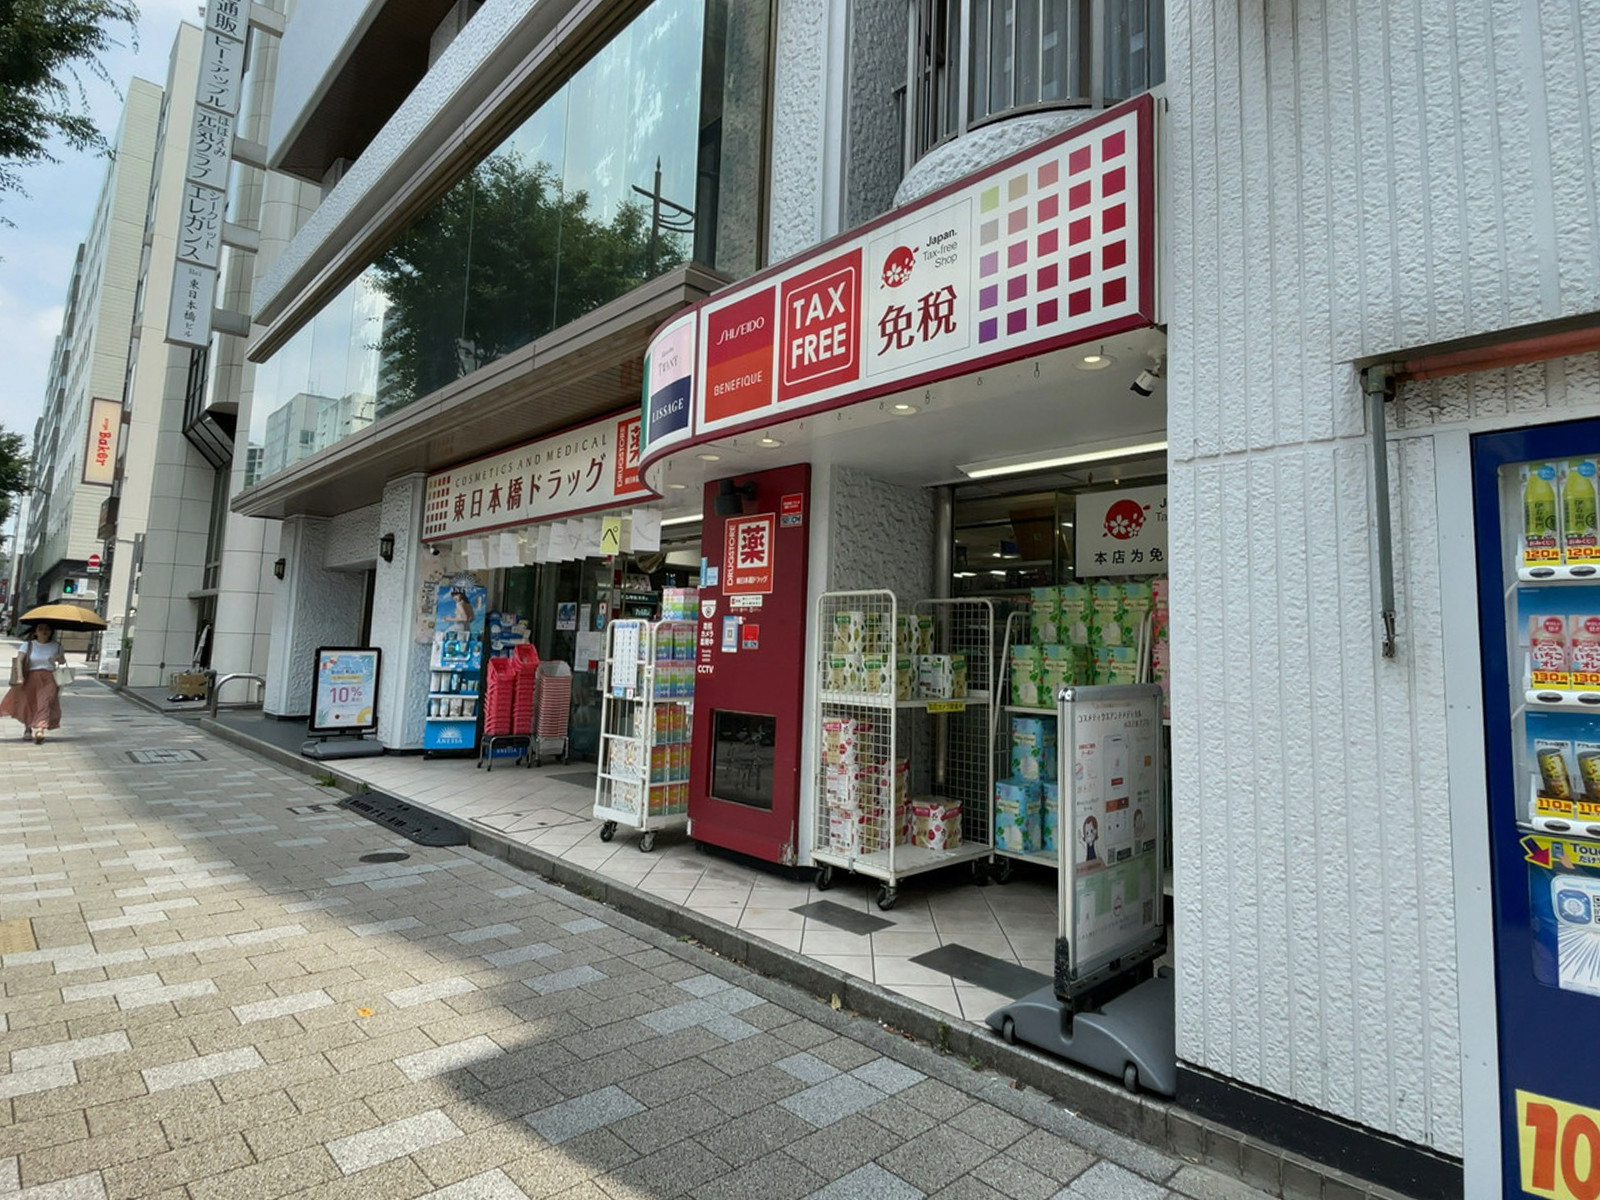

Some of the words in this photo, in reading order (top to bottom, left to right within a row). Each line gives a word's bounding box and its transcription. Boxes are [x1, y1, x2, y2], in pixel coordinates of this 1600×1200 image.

[215, 0, 239, 36] 通販
[192, 110, 217, 178] 元気クラブ
[181, 184, 206, 260] エレガンス
[205, 192, 220, 250] シークレット
[926, 228, 958, 247] Japan.
[922, 241, 958, 262] Tax-free
[934, 253, 958, 269] Shop
[792, 281, 846, 330] TAX
[716, 316, 765, 346] SHISEIDO
[791, 322, 847, 370] FREE
[713, 370, 763, 397] BENEFIQUE
[652, 397, 684, 424] LISSAGE
[455, 463, 513, 488] COSMETICS
[517, 453, 541, 471] AND
[546, 433, 607, 463] MEDICAL
[616, 425, 626, 488] DRUGSTORE
[452, 453, 607, 523] 東日本橋ドラッグ
[727, 525, 736, 586] DRUGSTORE
[740, 524, 766, 564] 薬
[1094, 547, 1164, 565] 本店为免
[697, 665, 714, 674] CCTV
[436, 736, 463, 744] ANESSA
[1569, 843, 1600, 856] Tou
[1579, 855, 1600, 864] だけ
